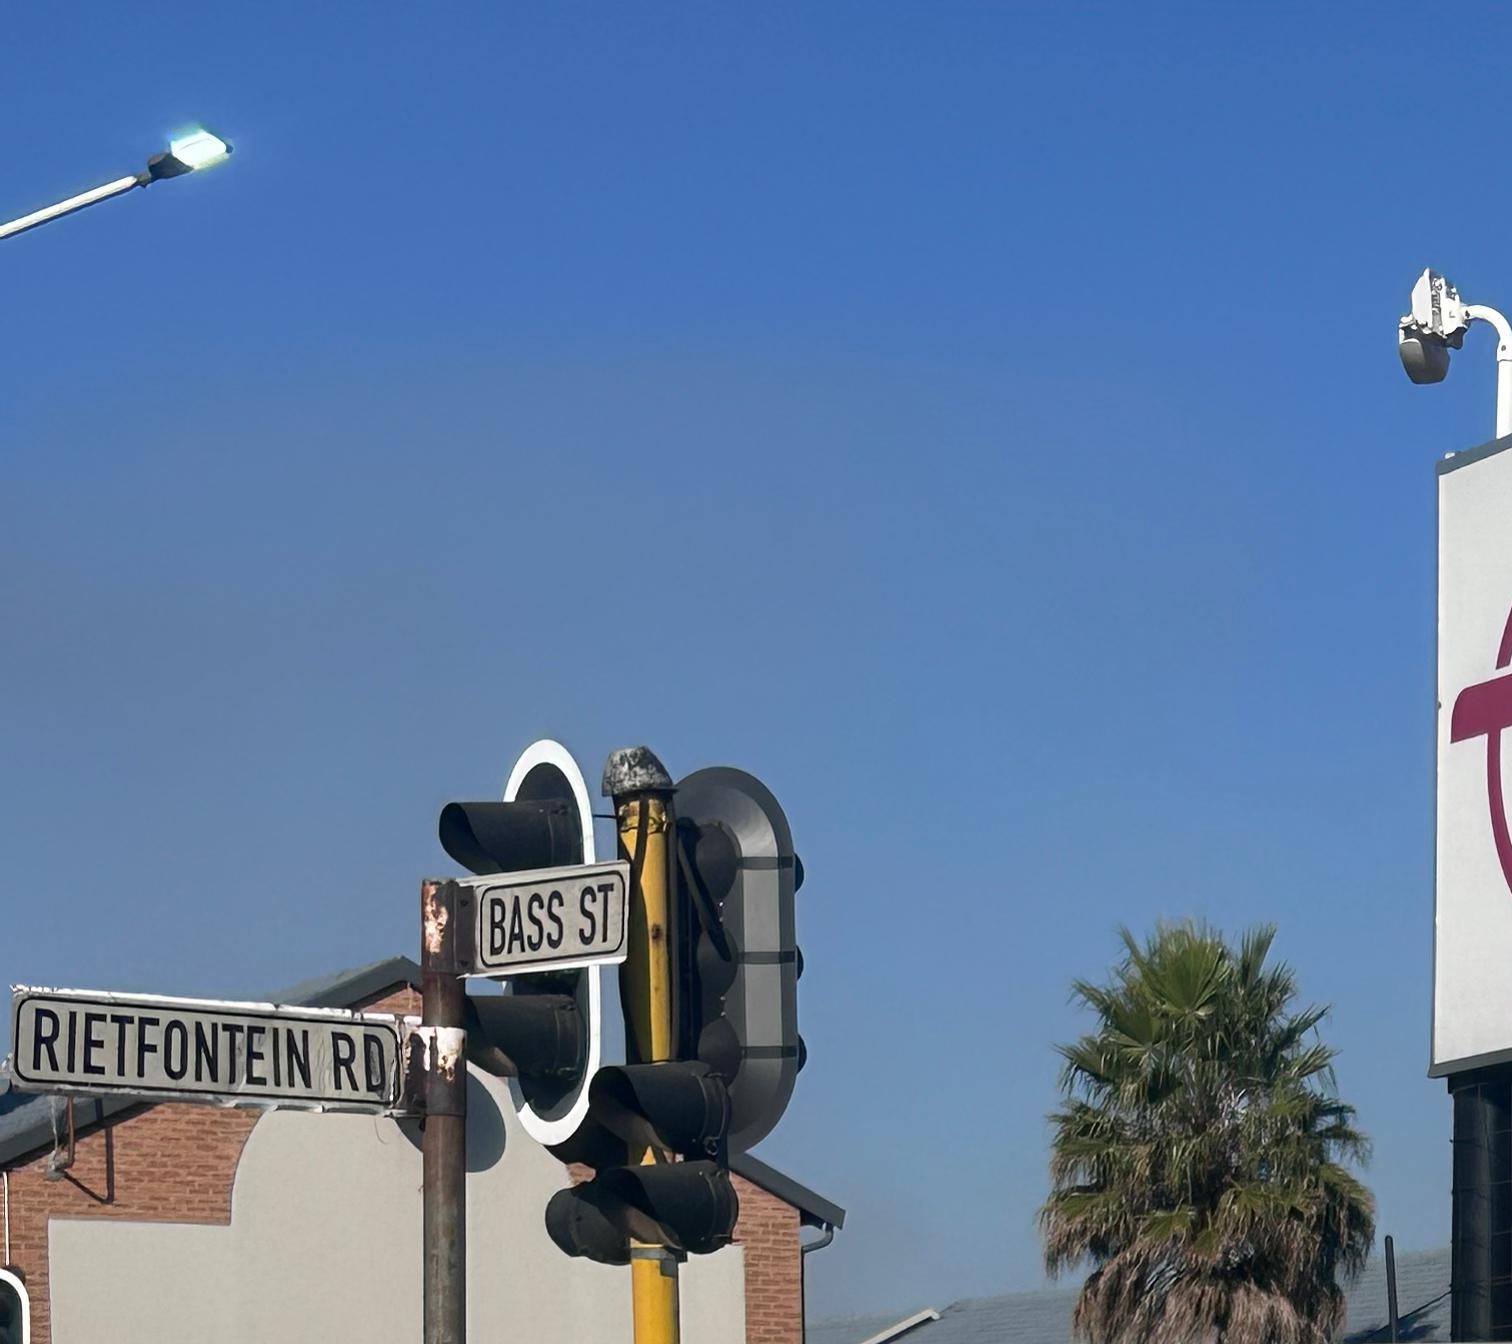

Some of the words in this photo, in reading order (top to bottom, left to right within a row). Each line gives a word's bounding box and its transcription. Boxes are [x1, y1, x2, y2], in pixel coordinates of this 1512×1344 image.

[489, 889, 565, 957] BASS
[578, 882, 615, 946] ST
[32, 1007, 312, 1089] RIETFONTEIN
[331, 1031, 387, 1095] RD
